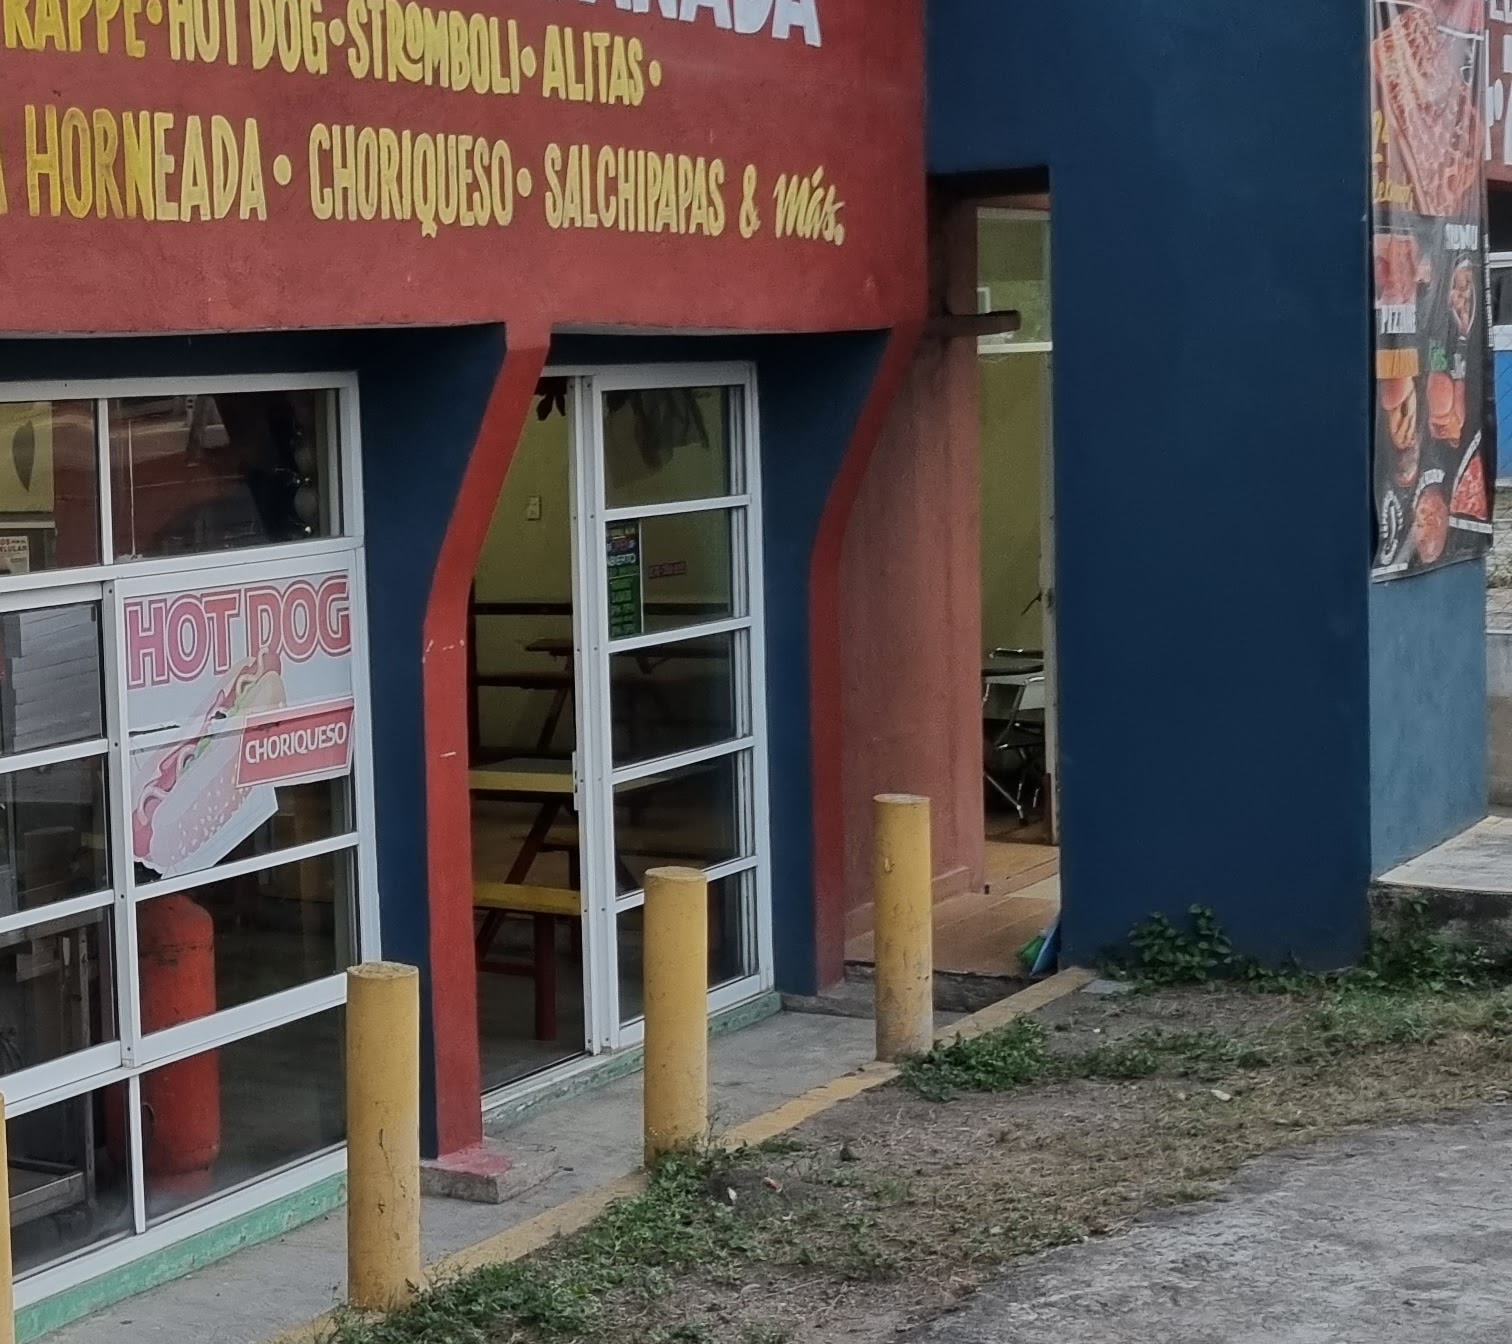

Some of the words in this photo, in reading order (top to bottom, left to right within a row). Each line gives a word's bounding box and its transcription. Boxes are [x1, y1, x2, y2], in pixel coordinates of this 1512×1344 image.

[542, 25, 645, 106] ALITAS
[25, 105, 267, 223] HORNEADA
[308, 123, 515, 237] CHORIQUESO
[544, 143, 725, 237] SALCHIPAPAS
[739, 164, 762, 239] &
[124, 589, 241, 690] HOT
[245, 574, 352, 664] DOG
[245, 721, 347, 765] CHORIQUESO
